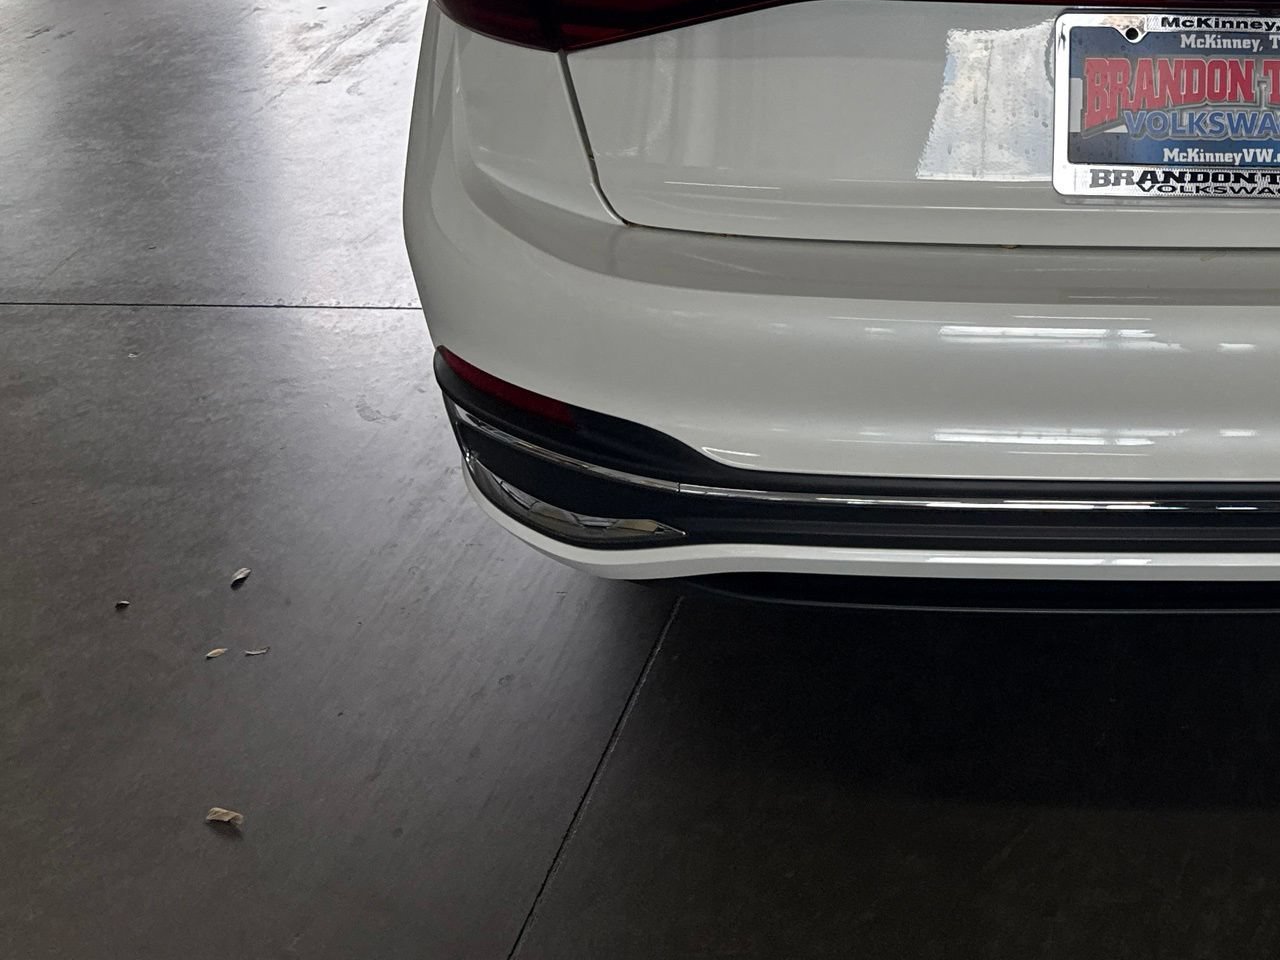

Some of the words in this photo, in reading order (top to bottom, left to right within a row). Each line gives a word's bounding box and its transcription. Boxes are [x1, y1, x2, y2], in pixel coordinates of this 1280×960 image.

[1161, 16, 1280, 31] McKinney,
[1180, 34, 1264, 52] McKinney,
[1084, 57, 1256, 130] BRANDON
[1089, 168, 1259, 188] BRANDON
